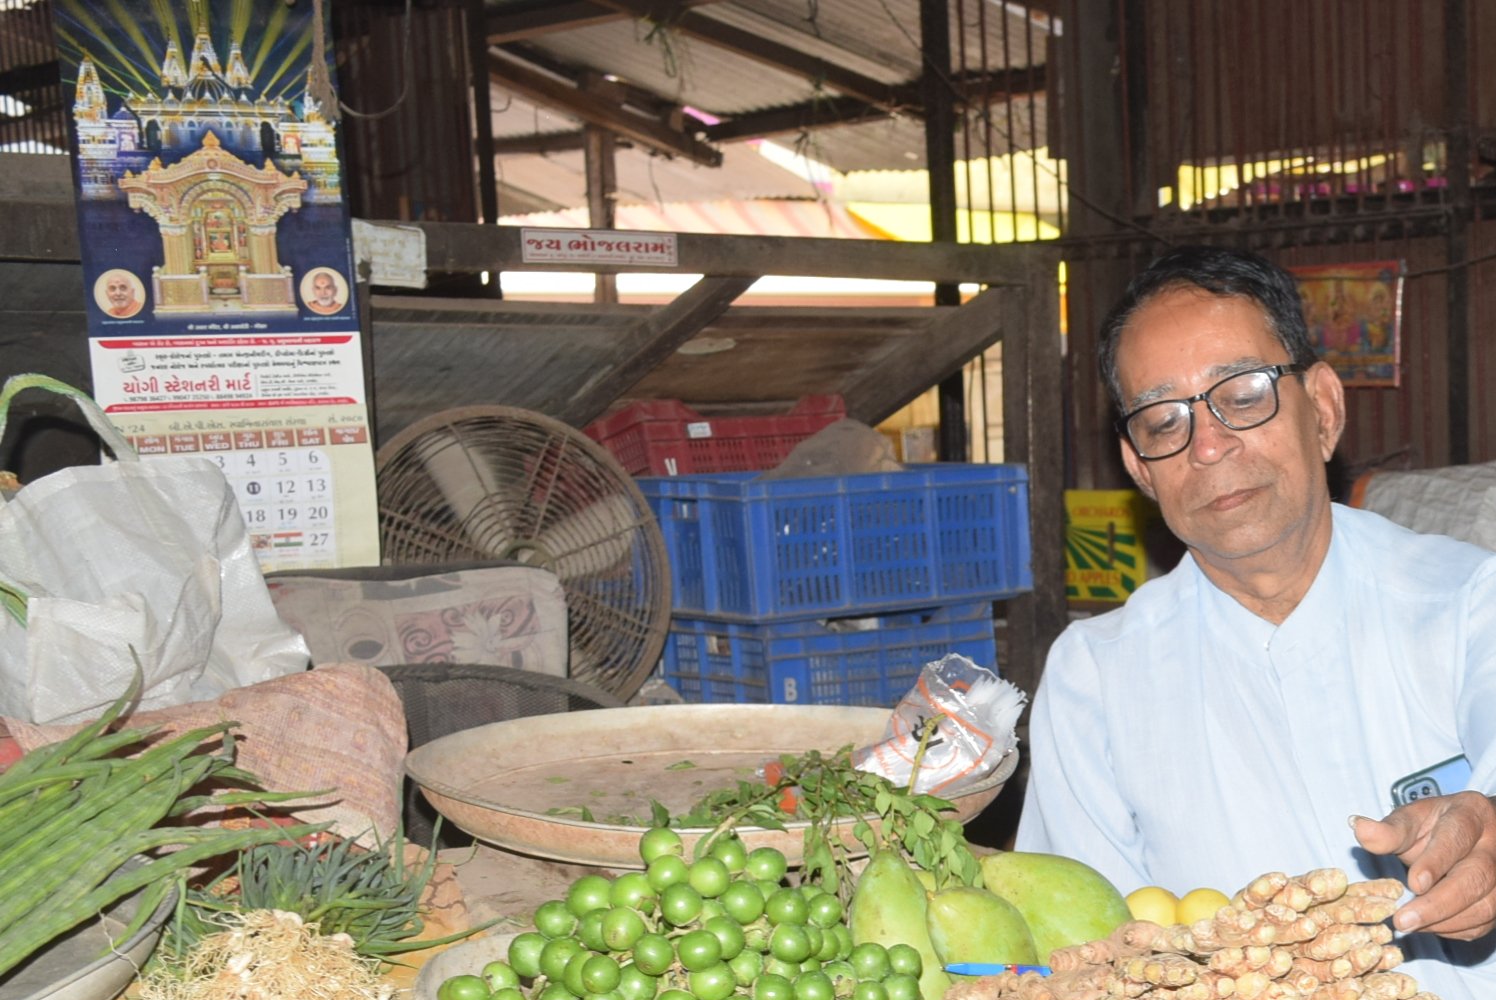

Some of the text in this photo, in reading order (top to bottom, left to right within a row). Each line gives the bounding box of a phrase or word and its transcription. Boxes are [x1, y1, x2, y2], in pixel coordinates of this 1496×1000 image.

[526, 238, 561, 251] જય
[567, 234, 666, 254] ભોજલરામ
[123, 375, 159, 394] યોગી
[164, 374, 220, 393] સ્ટેશનરી
[225, 372, 252, 391] માર્ટ
[204, 442, 229, 450] WED
[302, 437, 320, 445] SAT
[246, 453, 256, 467] 4
[278, 451, 288, 466] 5
[308, 450, 318, 464] 6
[276, 480, 296, 494] 12
[306, 478, 326, 492] 13
[246, 509, 266, 523] 18
[278, 507, 298, 520] 19
[308, 506, 328, 520] 20
[310, 532, 329, 547] 27
[784, 677, 798, 701] B
